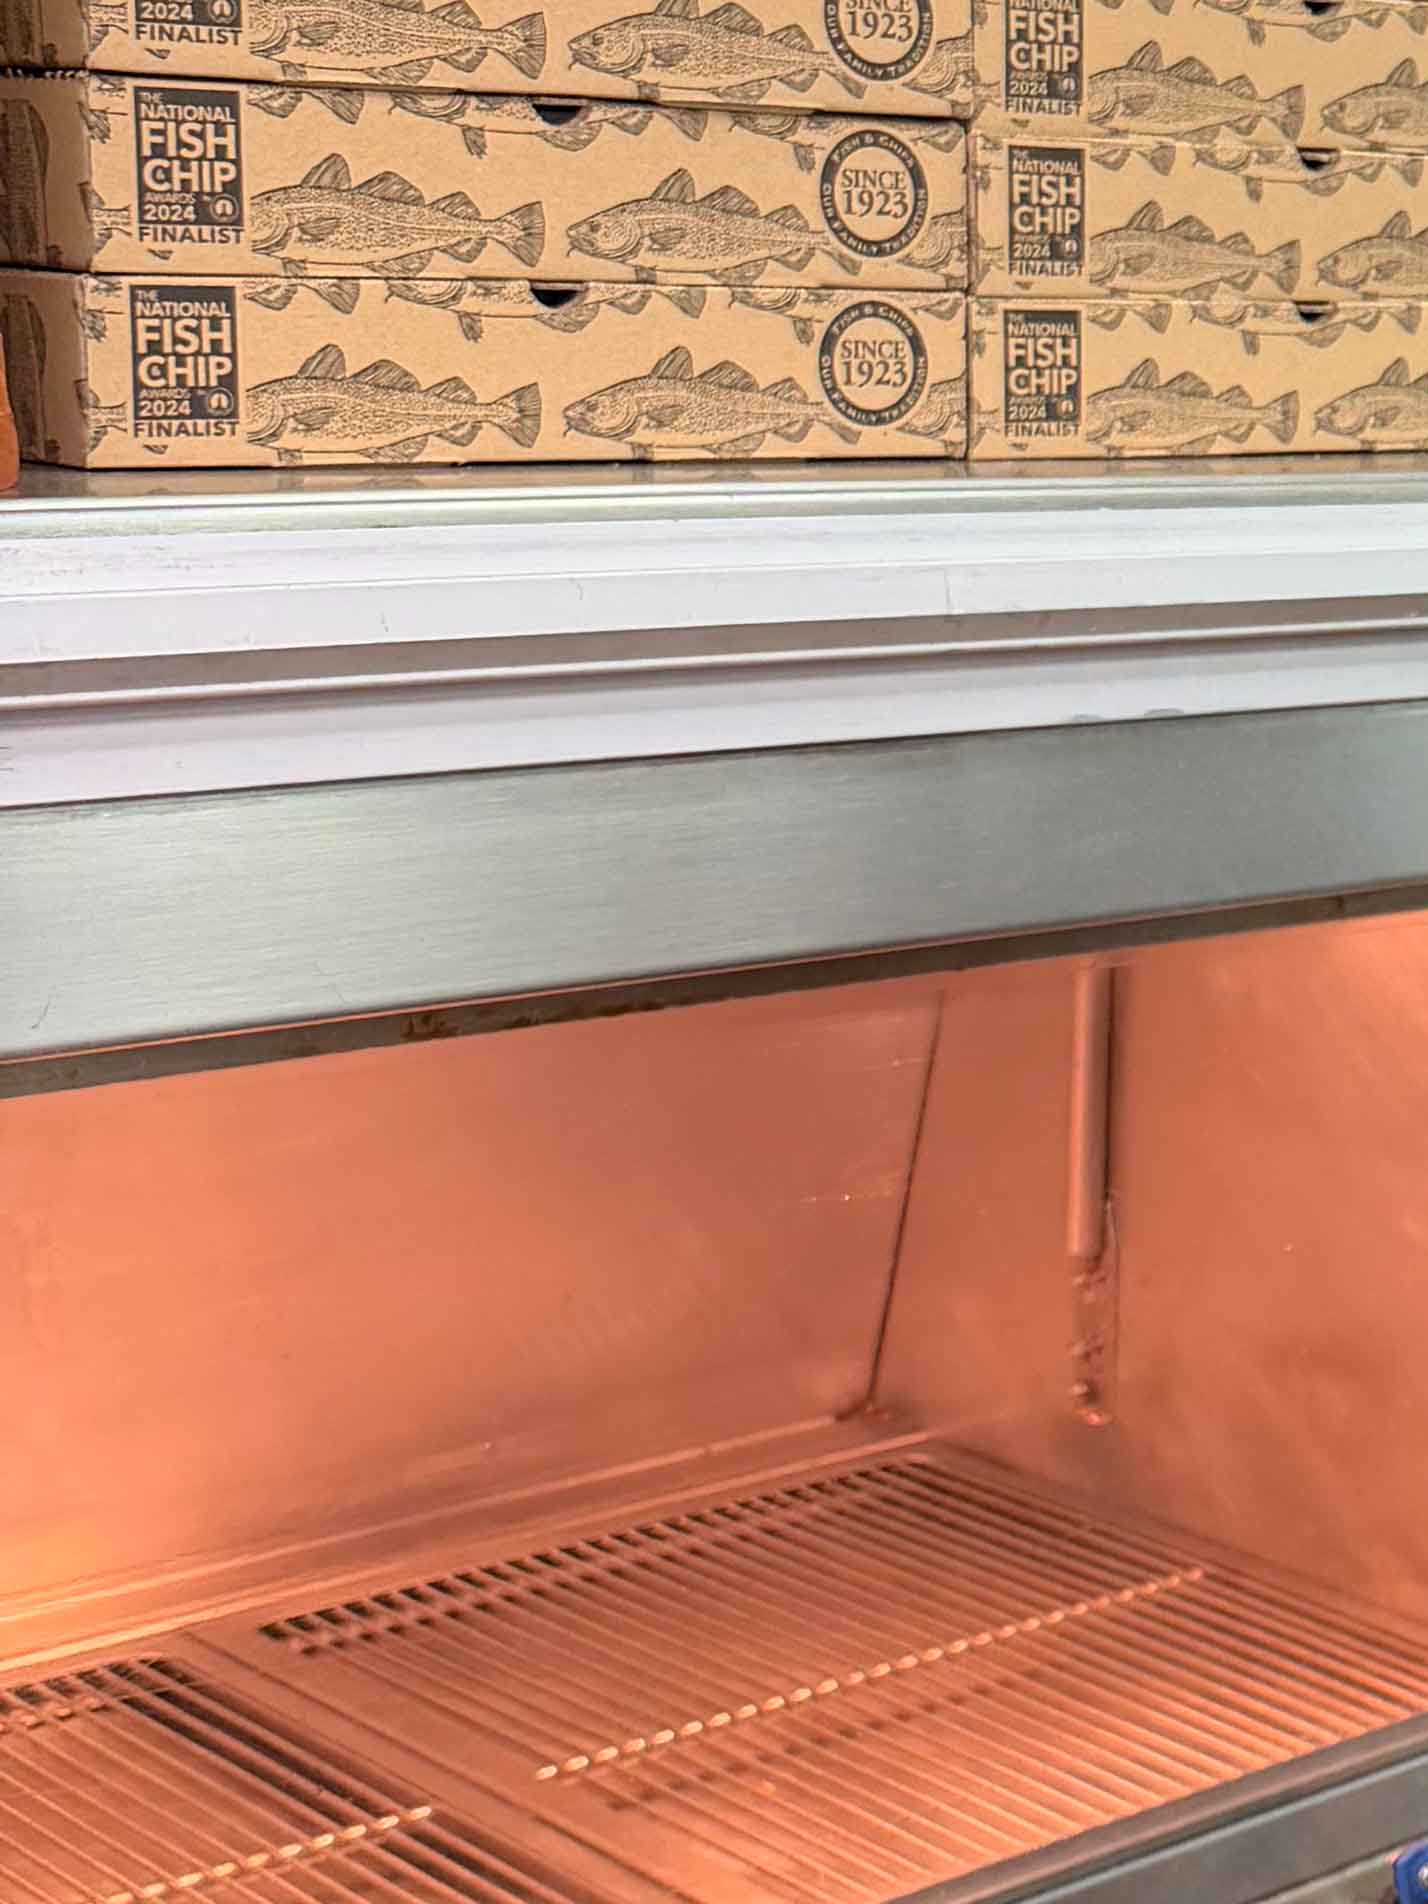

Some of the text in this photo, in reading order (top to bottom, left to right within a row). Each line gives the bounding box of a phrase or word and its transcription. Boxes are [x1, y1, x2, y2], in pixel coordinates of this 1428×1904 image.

[141, 2, 193, 20] 2024
[136, 24, 242, 45] FINALIST
[848, 12, 913, 42] 1923
[1010, 9, 1080, 43] FISH
[1010, 42, 1079, 71] CHIP
[141, 93, 163, 103] THE
[140, 105, 234, 122] NATIONAL
[141, 121, 236, 159] FISH
[143, 159, 237, 192] CHIP
[842, 170, 907, 189] SINCE
[146, 193, 195, 203] AWARDS
[1013, 174, 1081, 205] FISH
[144, 205, 195, 220] 2024
[844, 191, 908, 218] 1923
[1013, 206, 1081, 233] CHIP
[139, 226, 243, 243] FINALIST
[137, 291, 159, 300] THE
[136, 303, 230, 316] NATIONAL
[137, 319, 232, 353] FISH
[841, 340, 907, 359] SINCE
[1009, 338, 1078, 366] FISH
[138, 355, 232, 388] CHIP
[843, 360, 907, 386] 1923
[1009, 368, 1077, 396] CHIP
[141, 390, 191, 399] AWARDS
[140, 400, 190, 416] 2024
[135, 421, 239, 438] FINALIST
